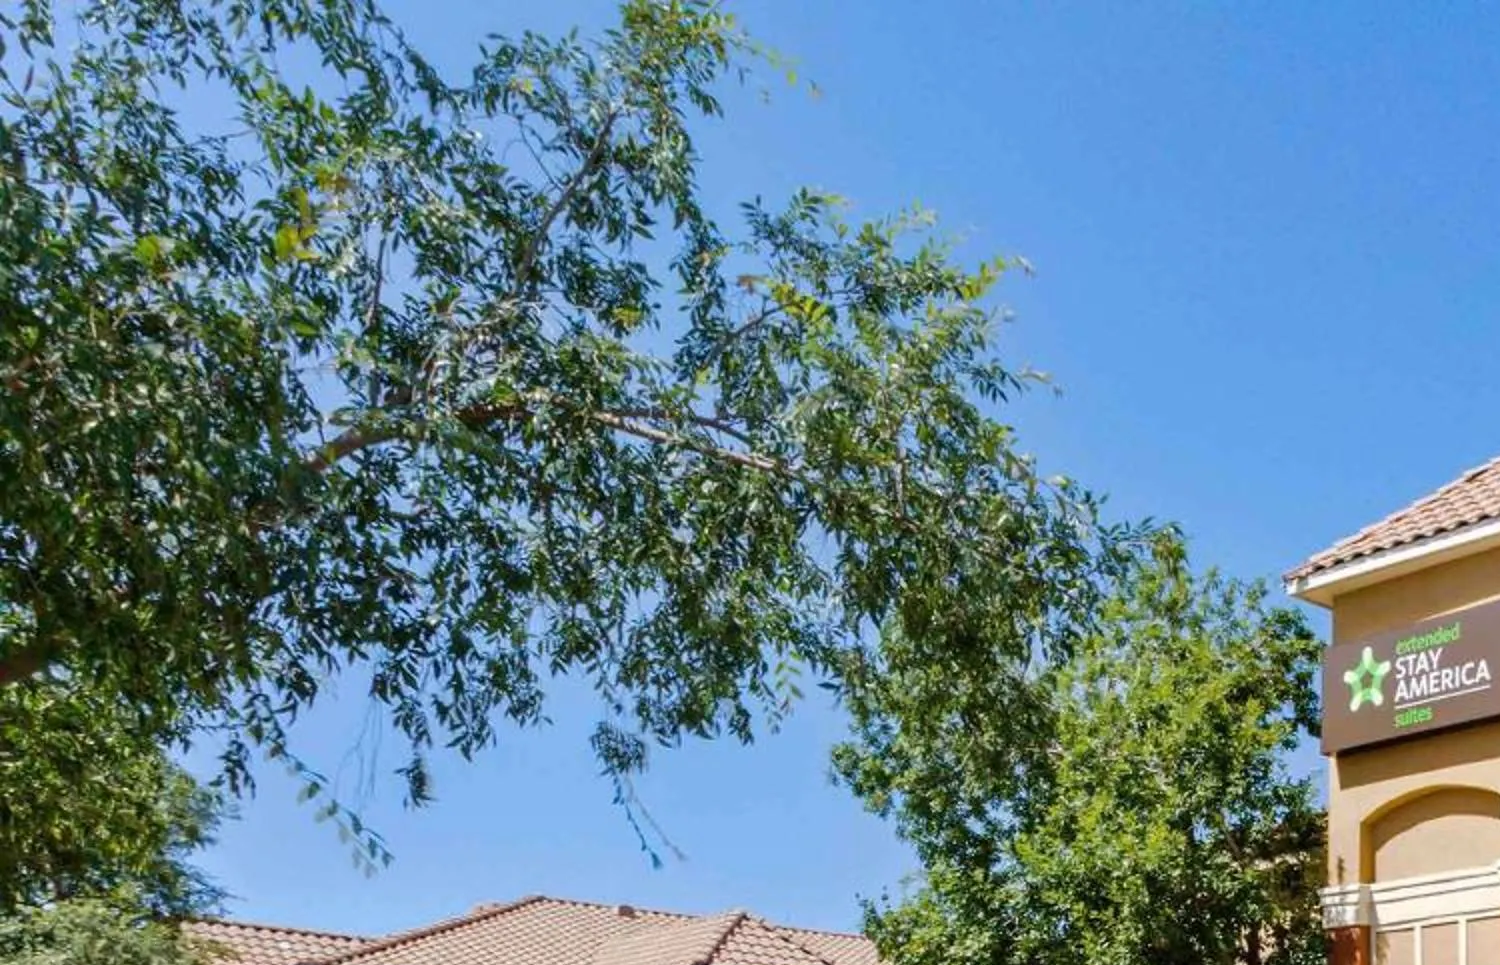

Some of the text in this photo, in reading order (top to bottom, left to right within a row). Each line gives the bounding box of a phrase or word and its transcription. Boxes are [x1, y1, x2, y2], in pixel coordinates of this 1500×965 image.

[1396, 622, 1461, 653] extended
[1395, 648, 1443, 679] STAY
[1395, 659, 1492, 702] AMERICA
[1394, 707, 1433, 727] suites
